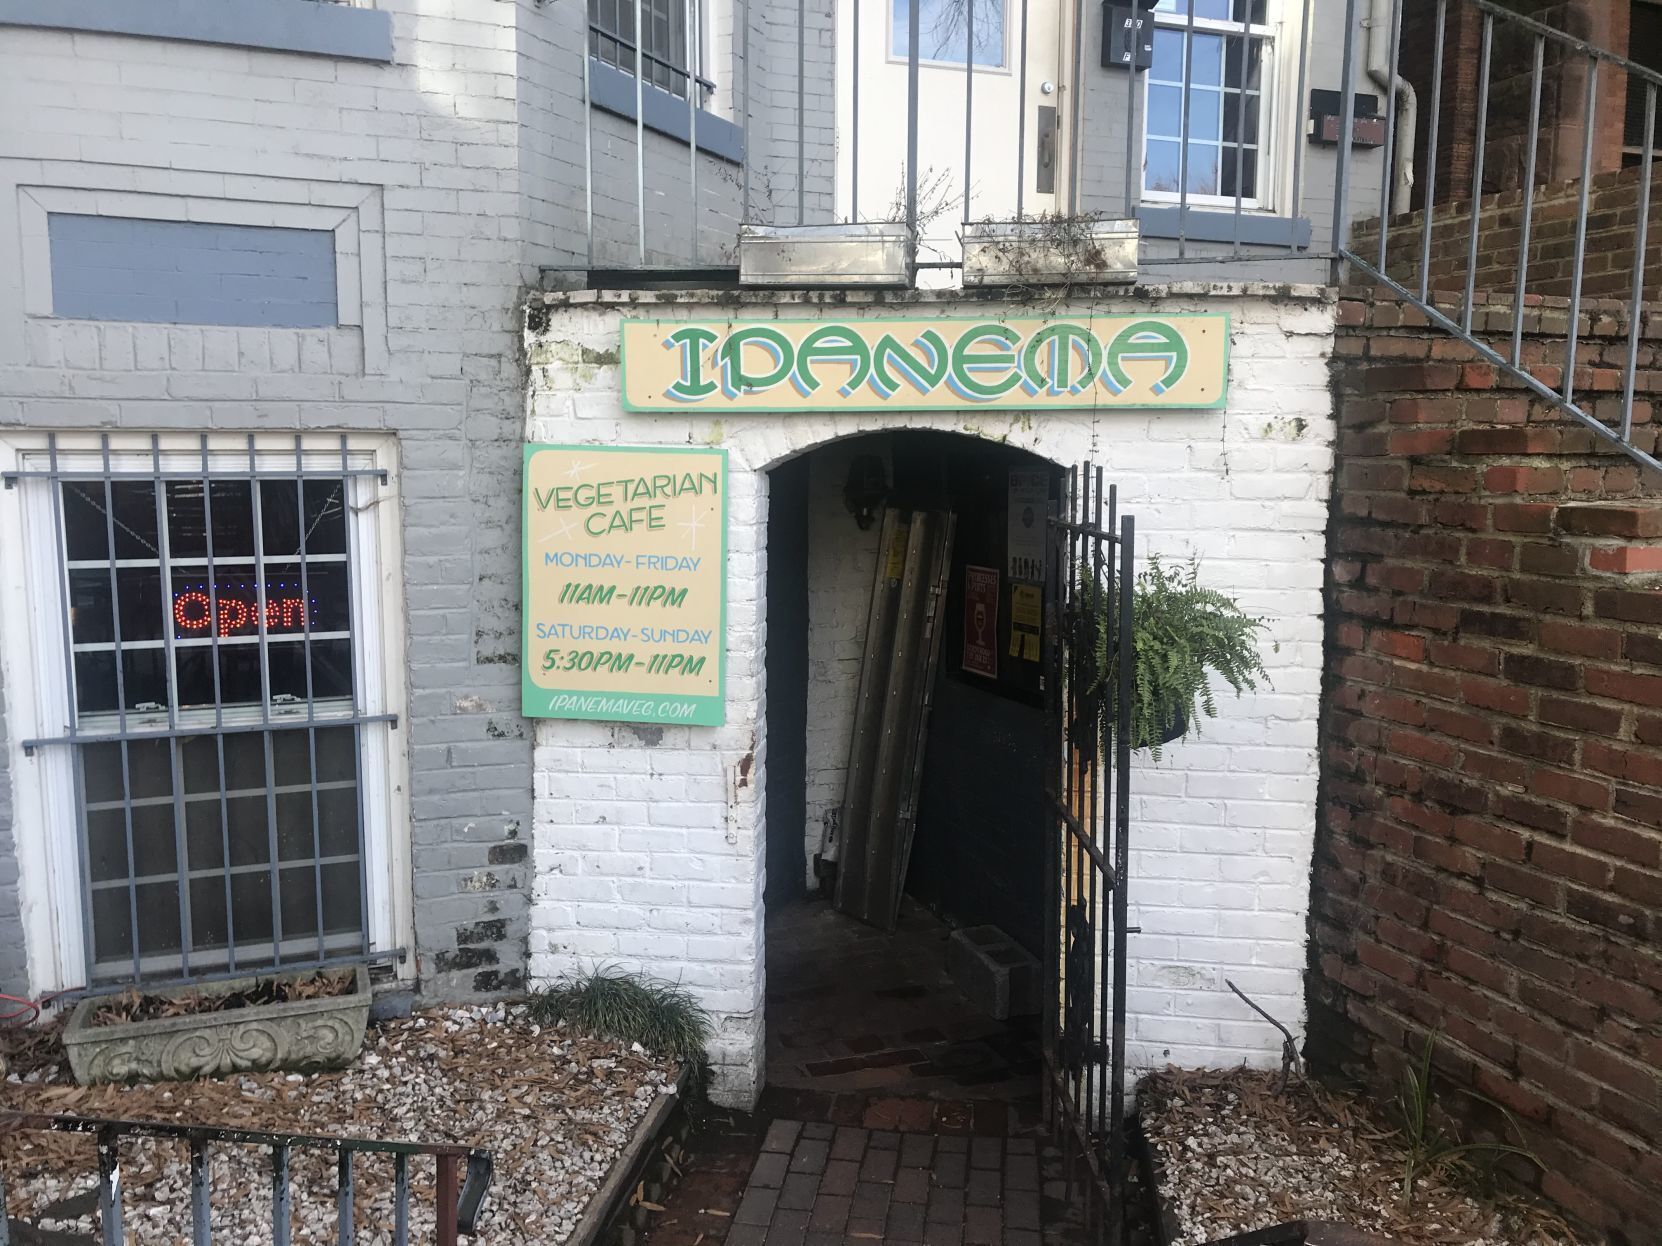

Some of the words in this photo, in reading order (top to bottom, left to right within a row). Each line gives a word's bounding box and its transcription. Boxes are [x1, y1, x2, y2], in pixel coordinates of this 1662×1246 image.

[662, 321, 1190, 401] IPANEMA
[533, 472, 718, 511] VEGETARIAN
[584, 505, 666, 536] CAFE
[174, 592, 305, 638] Open
[548, 694, 697, 719] IPANEMAVEG.COM
